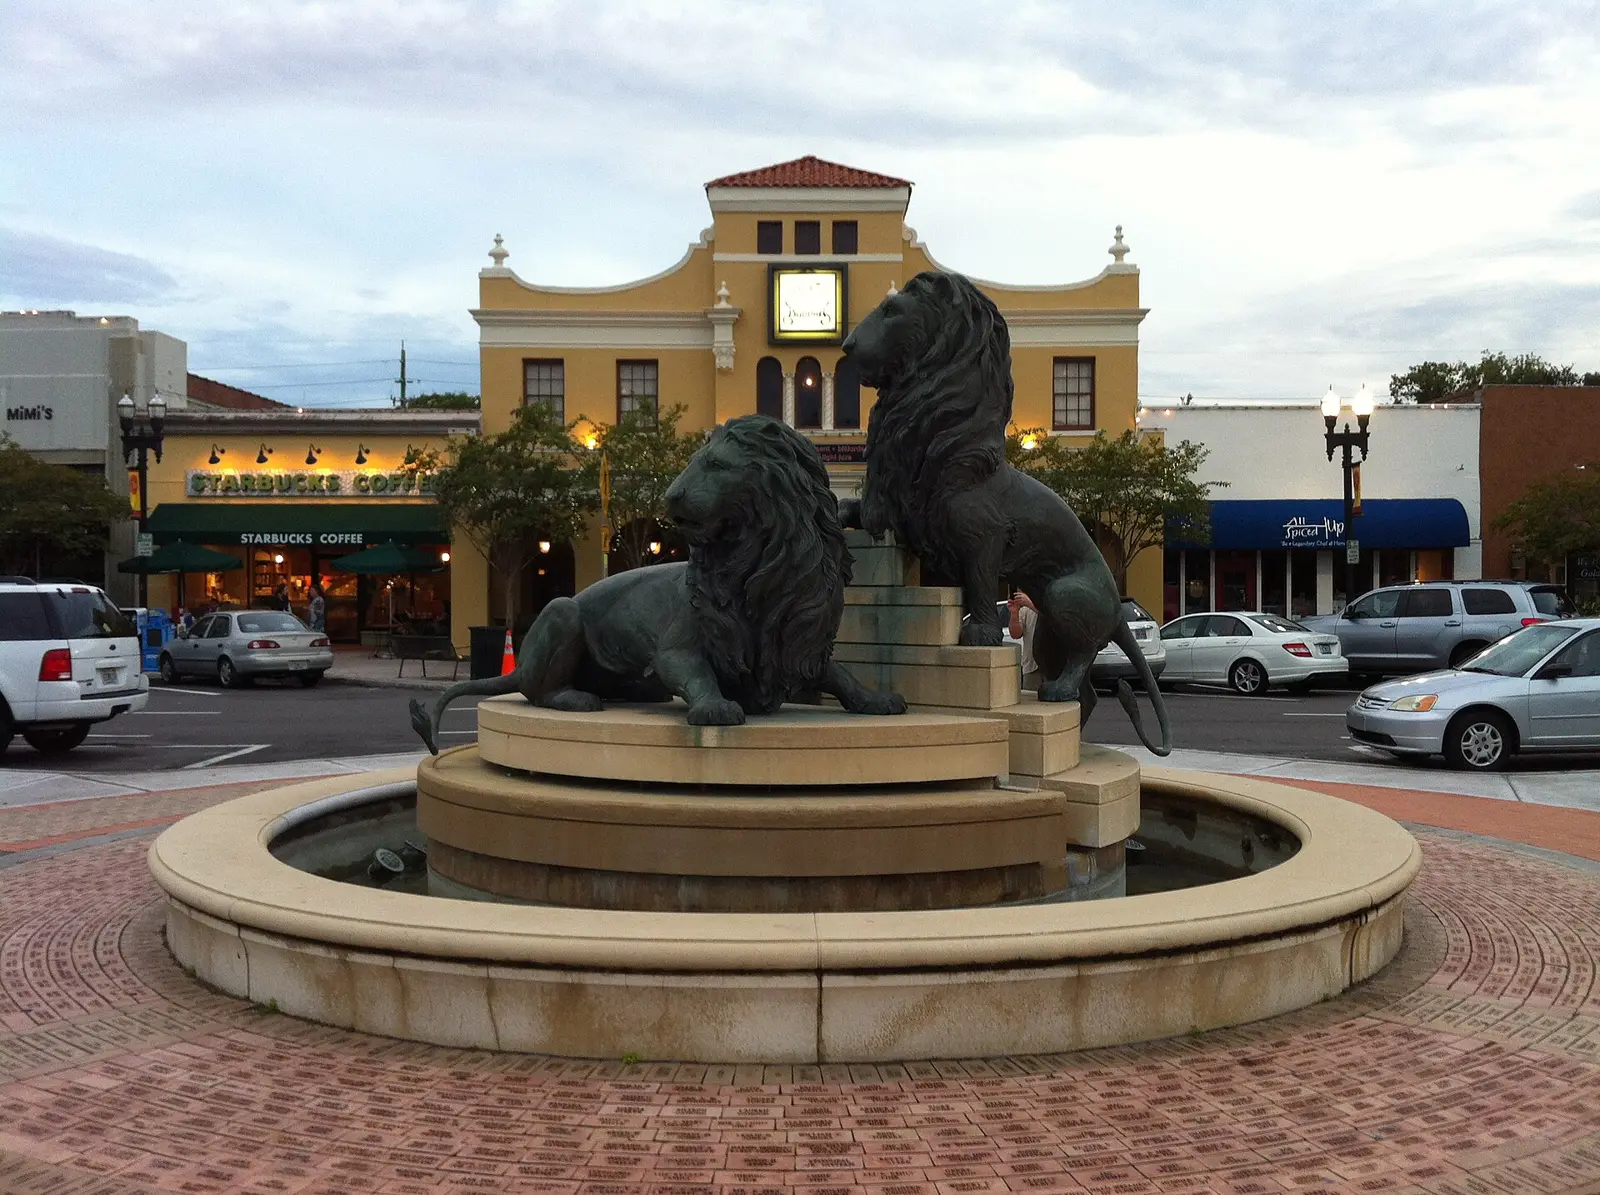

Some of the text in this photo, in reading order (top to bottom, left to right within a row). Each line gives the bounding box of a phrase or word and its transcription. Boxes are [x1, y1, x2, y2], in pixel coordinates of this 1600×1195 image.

[191, 473, 443, 492] STARBUCKS COFFE
[1287, 516, 1306, 526] All
[240, 533, 363, 544] STARBUCKS COFFEE
